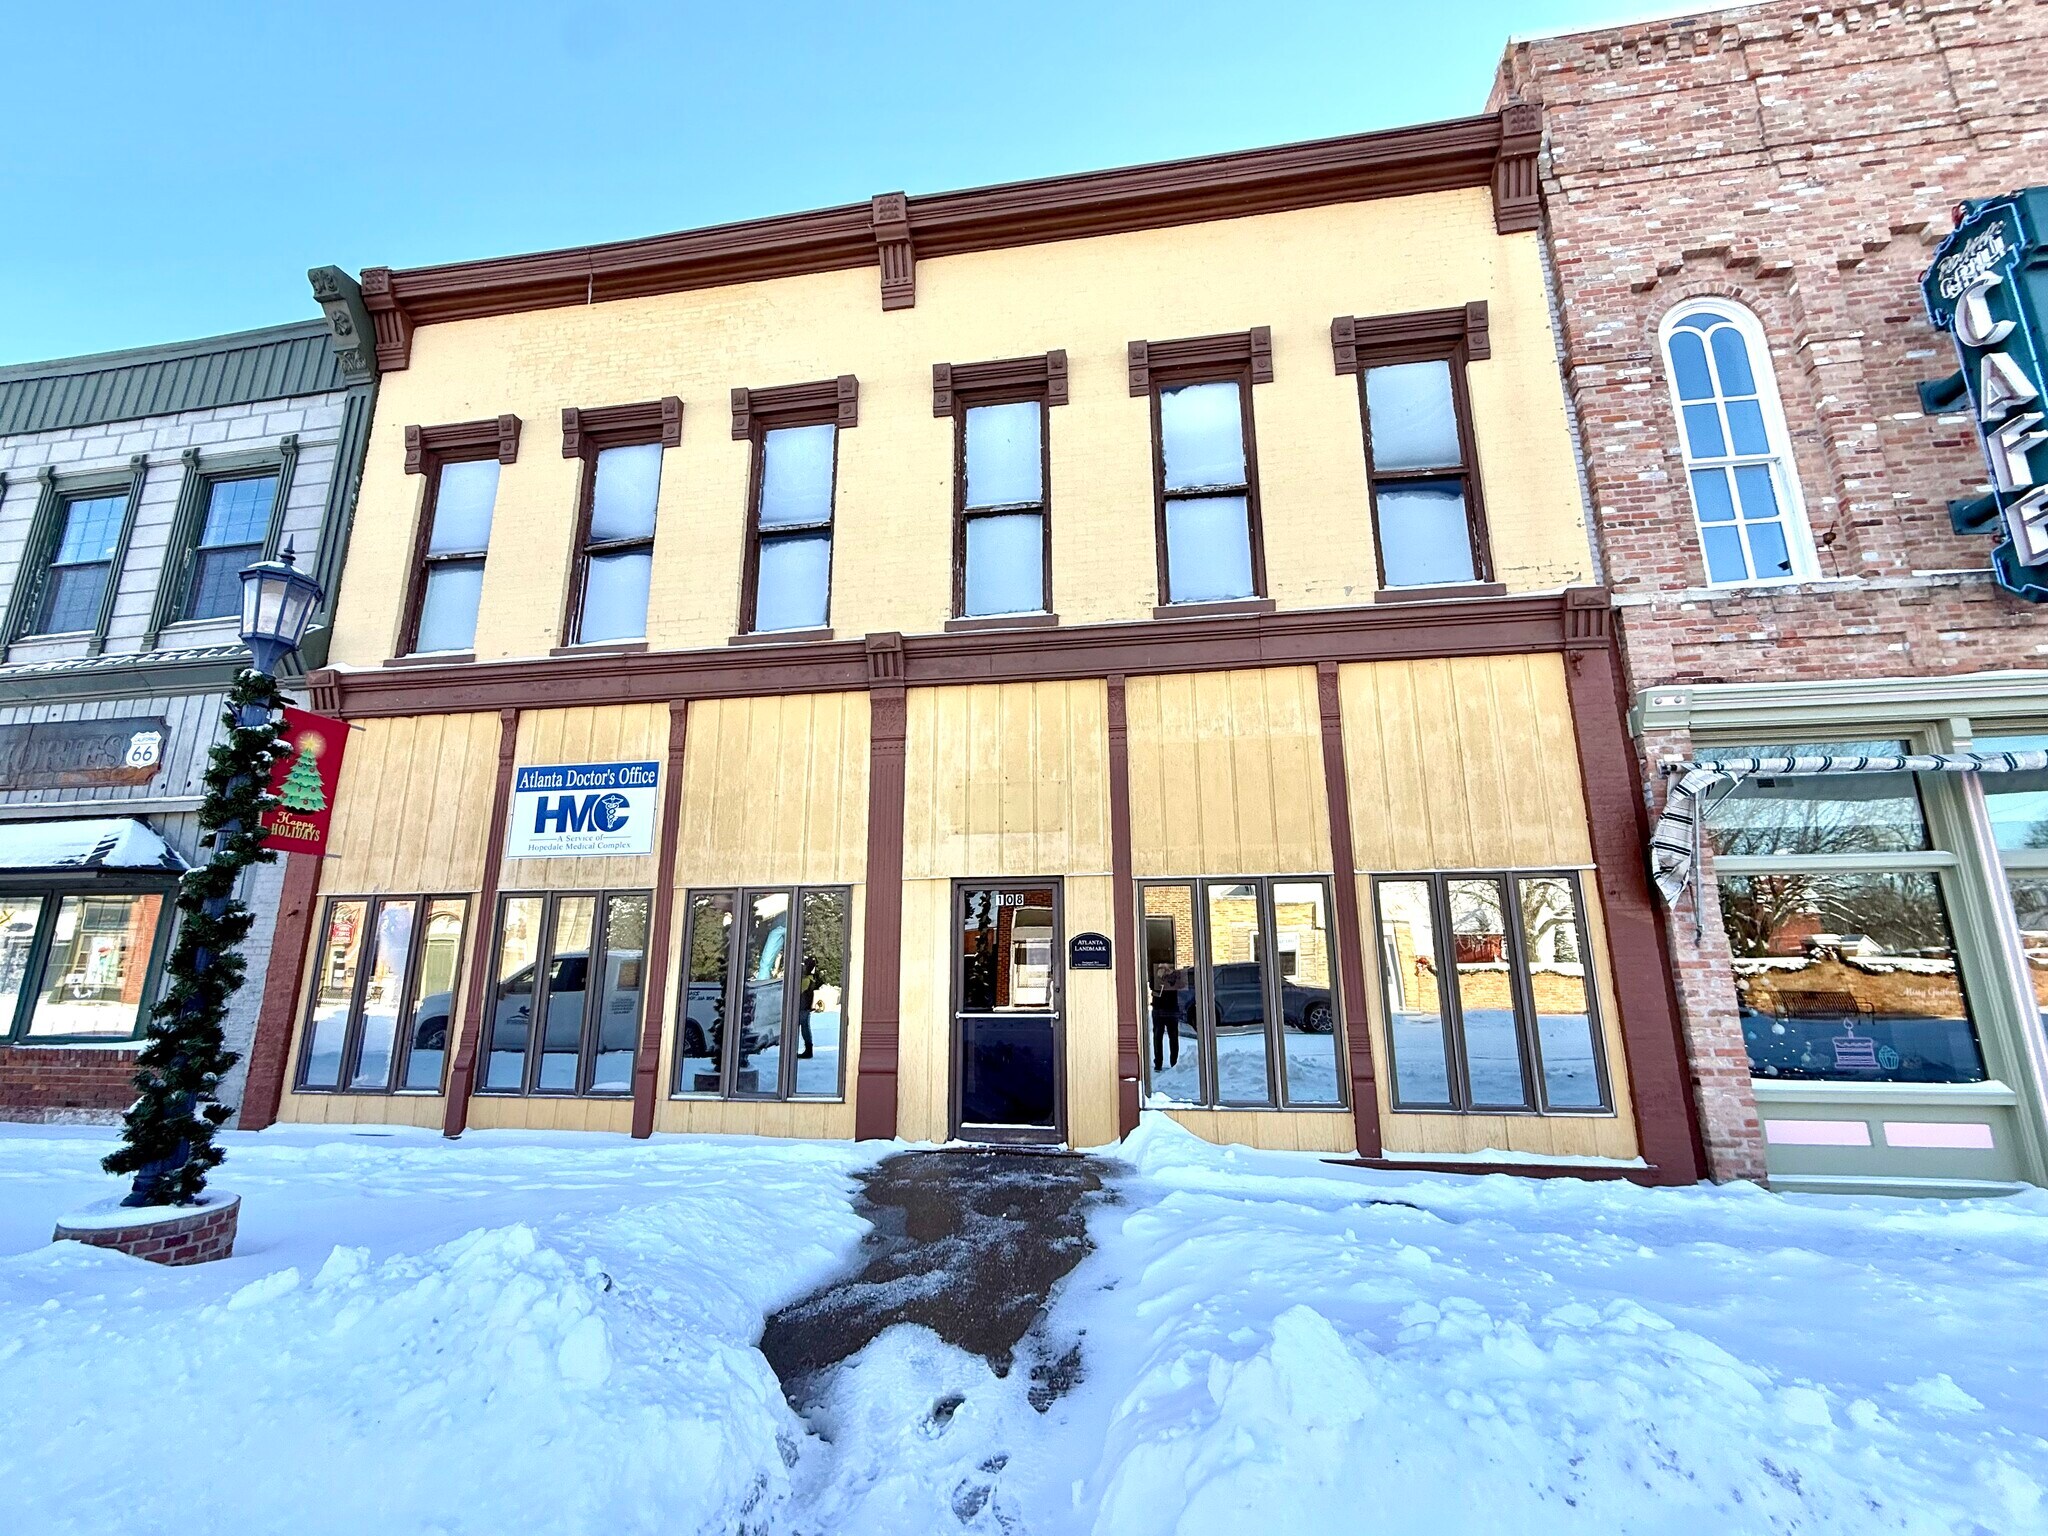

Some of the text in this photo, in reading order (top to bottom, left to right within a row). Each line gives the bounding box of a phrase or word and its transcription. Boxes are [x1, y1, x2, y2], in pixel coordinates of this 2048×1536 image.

[132, 745, 153, 762] 66
[518, 766, 656, 789] Atlanta Doctor's Office
[276, 811, 317, 831] Happy
[533, 793, 631, 834] HMC
[271, 822, 321, 842] HOLIDAYS
[566, 834, 593, 842] Service
[595, 833, 604, 841] of
[528, 841, 631, 852] Hopedale Medical Complex
[998, 895, 1023, 905] 108
